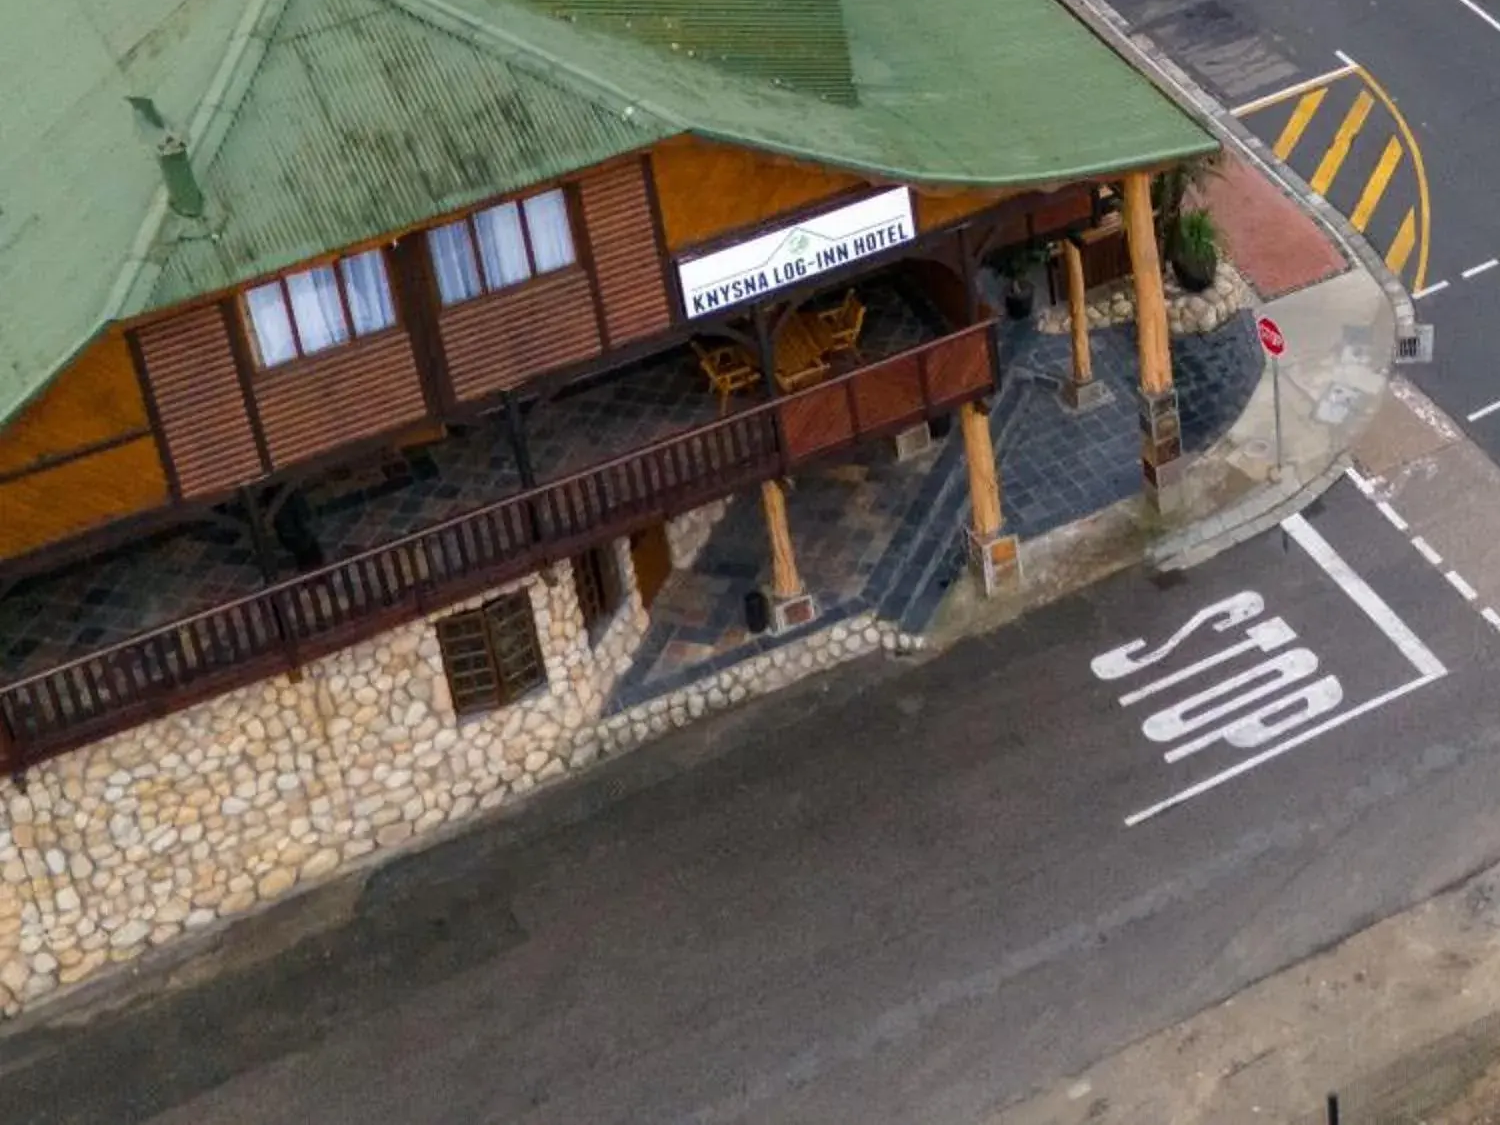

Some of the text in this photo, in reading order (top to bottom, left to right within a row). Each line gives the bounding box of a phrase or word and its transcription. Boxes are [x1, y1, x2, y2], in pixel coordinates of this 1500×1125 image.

[692, 222, 908, 313] KNYSNA LOG-INN HOTEL
[1090, 590, 1344, 764] STOP
